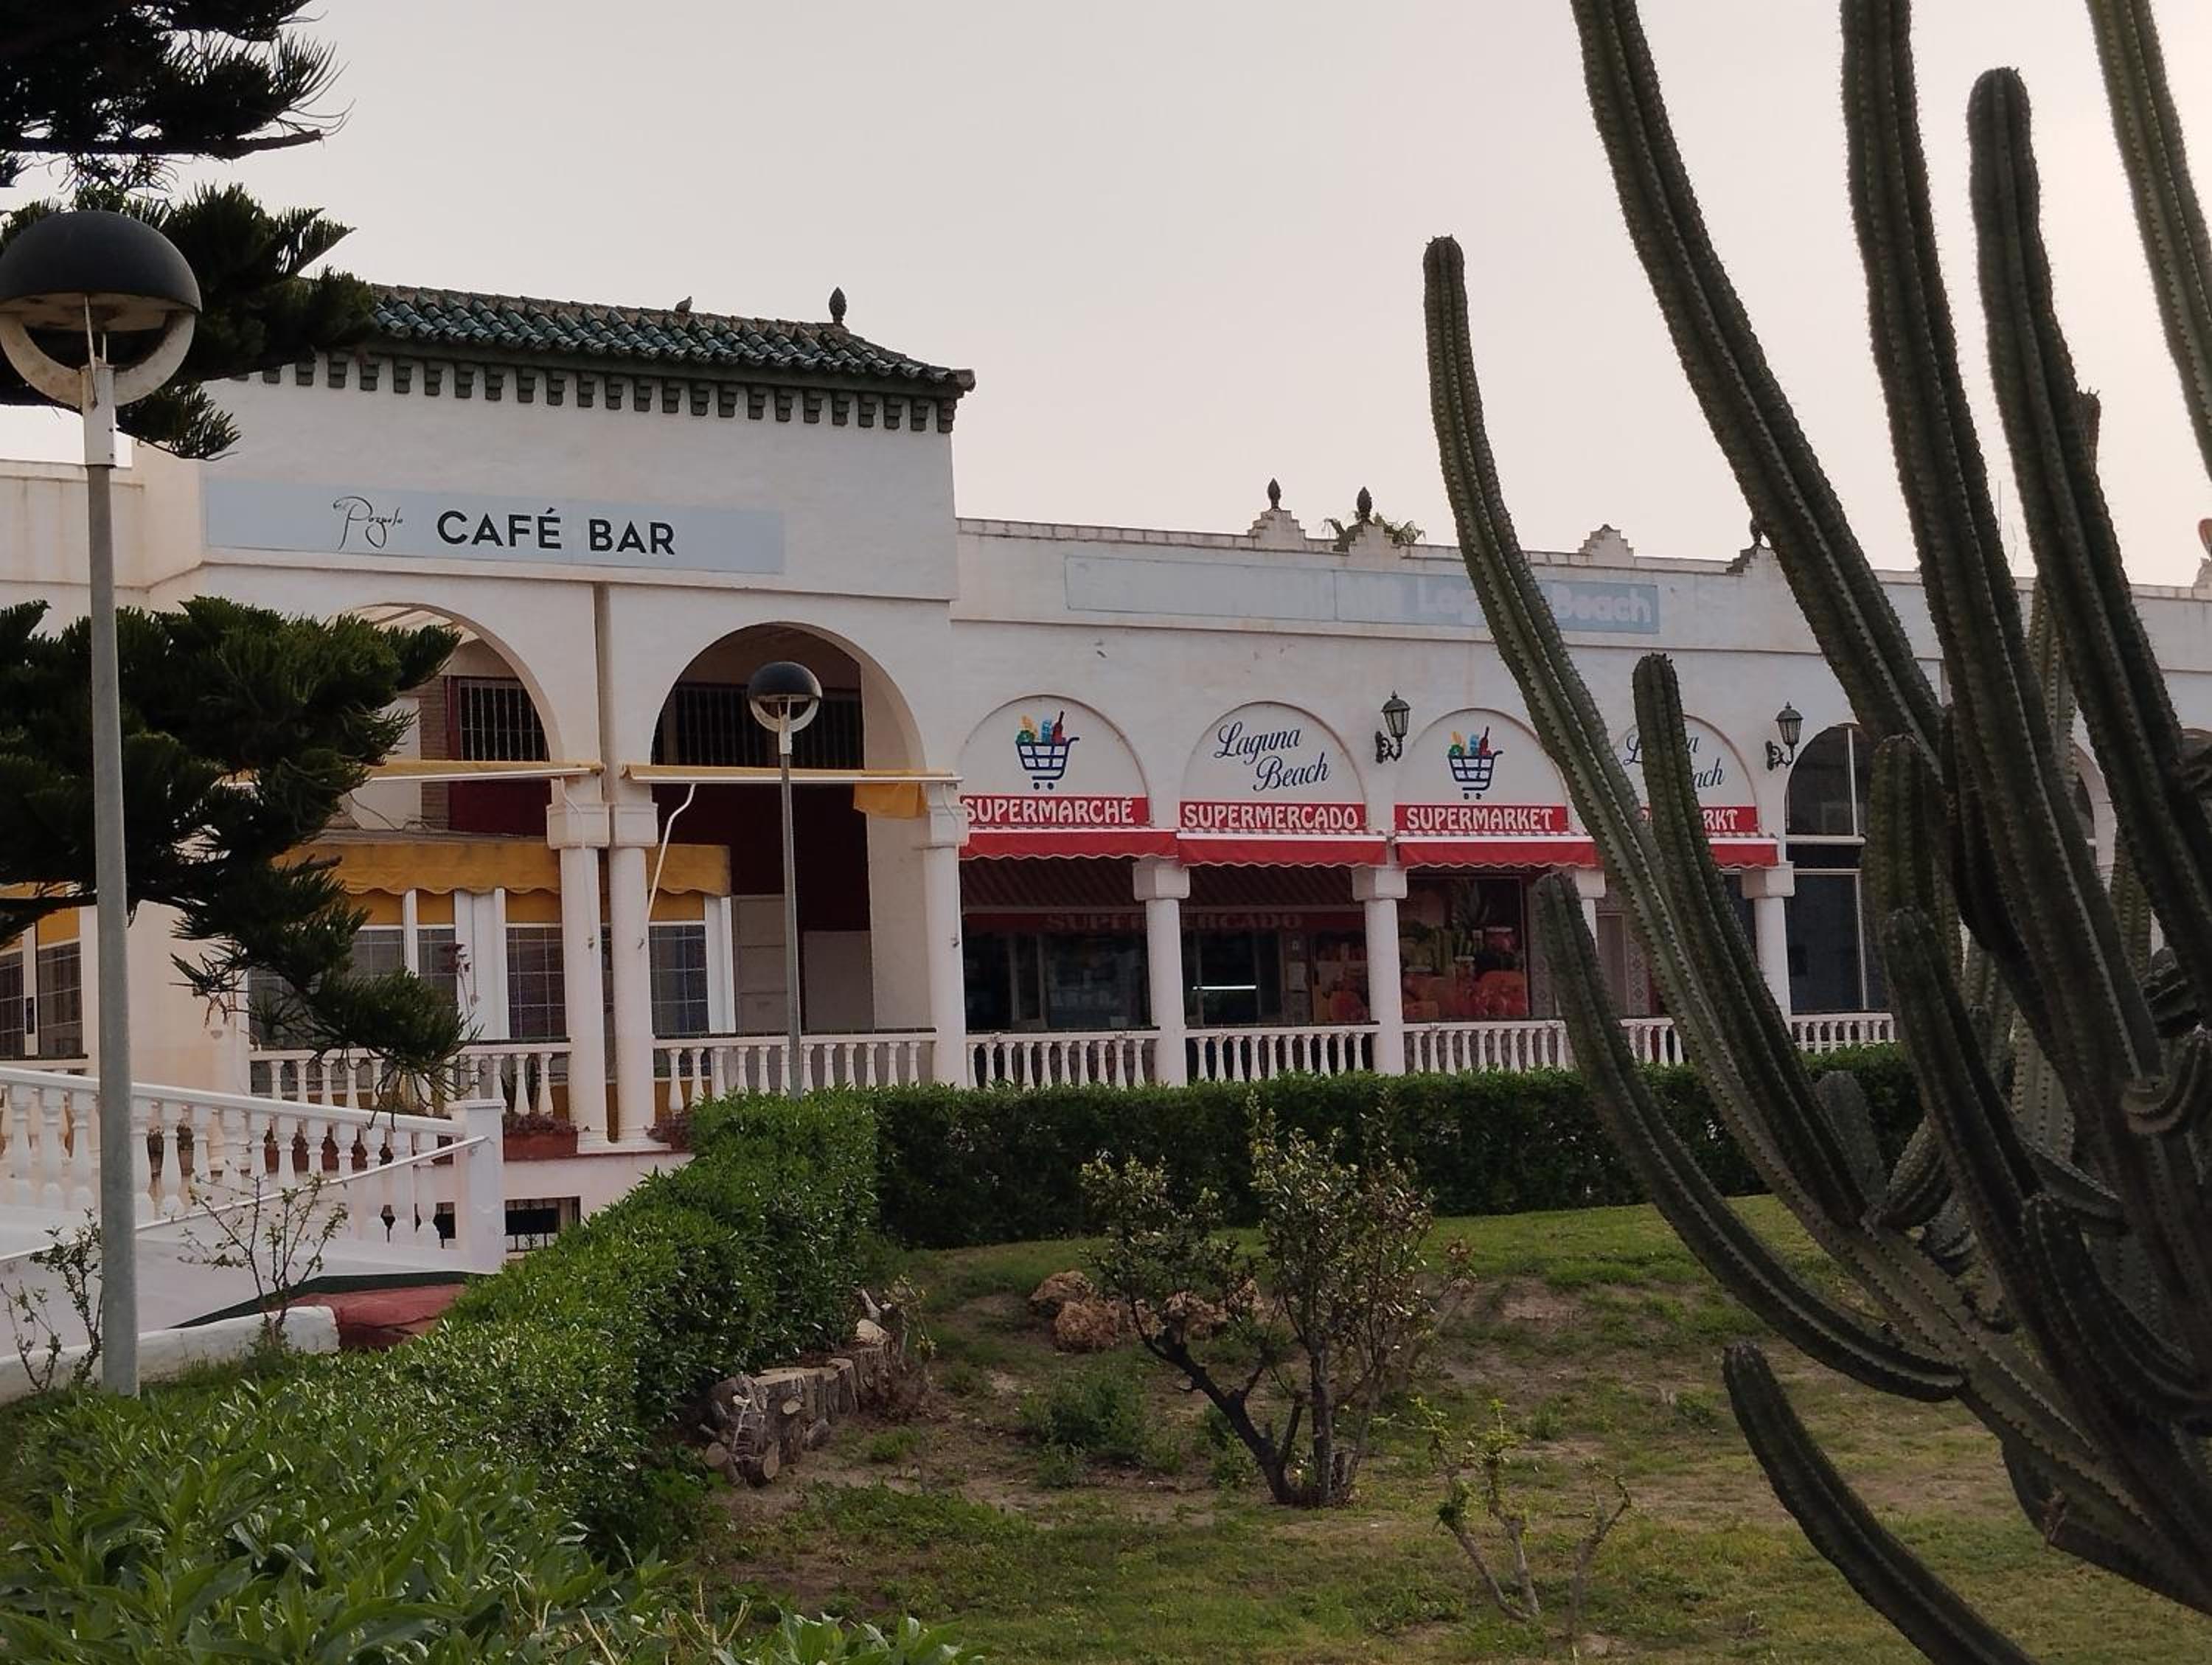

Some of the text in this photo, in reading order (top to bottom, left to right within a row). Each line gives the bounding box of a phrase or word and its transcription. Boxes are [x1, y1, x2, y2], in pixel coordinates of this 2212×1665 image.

[437, 507, 562, 549] CAFÉ
[589, 518, 675, 555] BAR
[1214, 721, 1301, 765] Laguna
[1253, 751, 1329, 791] Beach
[1184, 804, 1358, 830] SUPERMERCADO
[1407, 807, 1553, 830] SUPERMARKET
